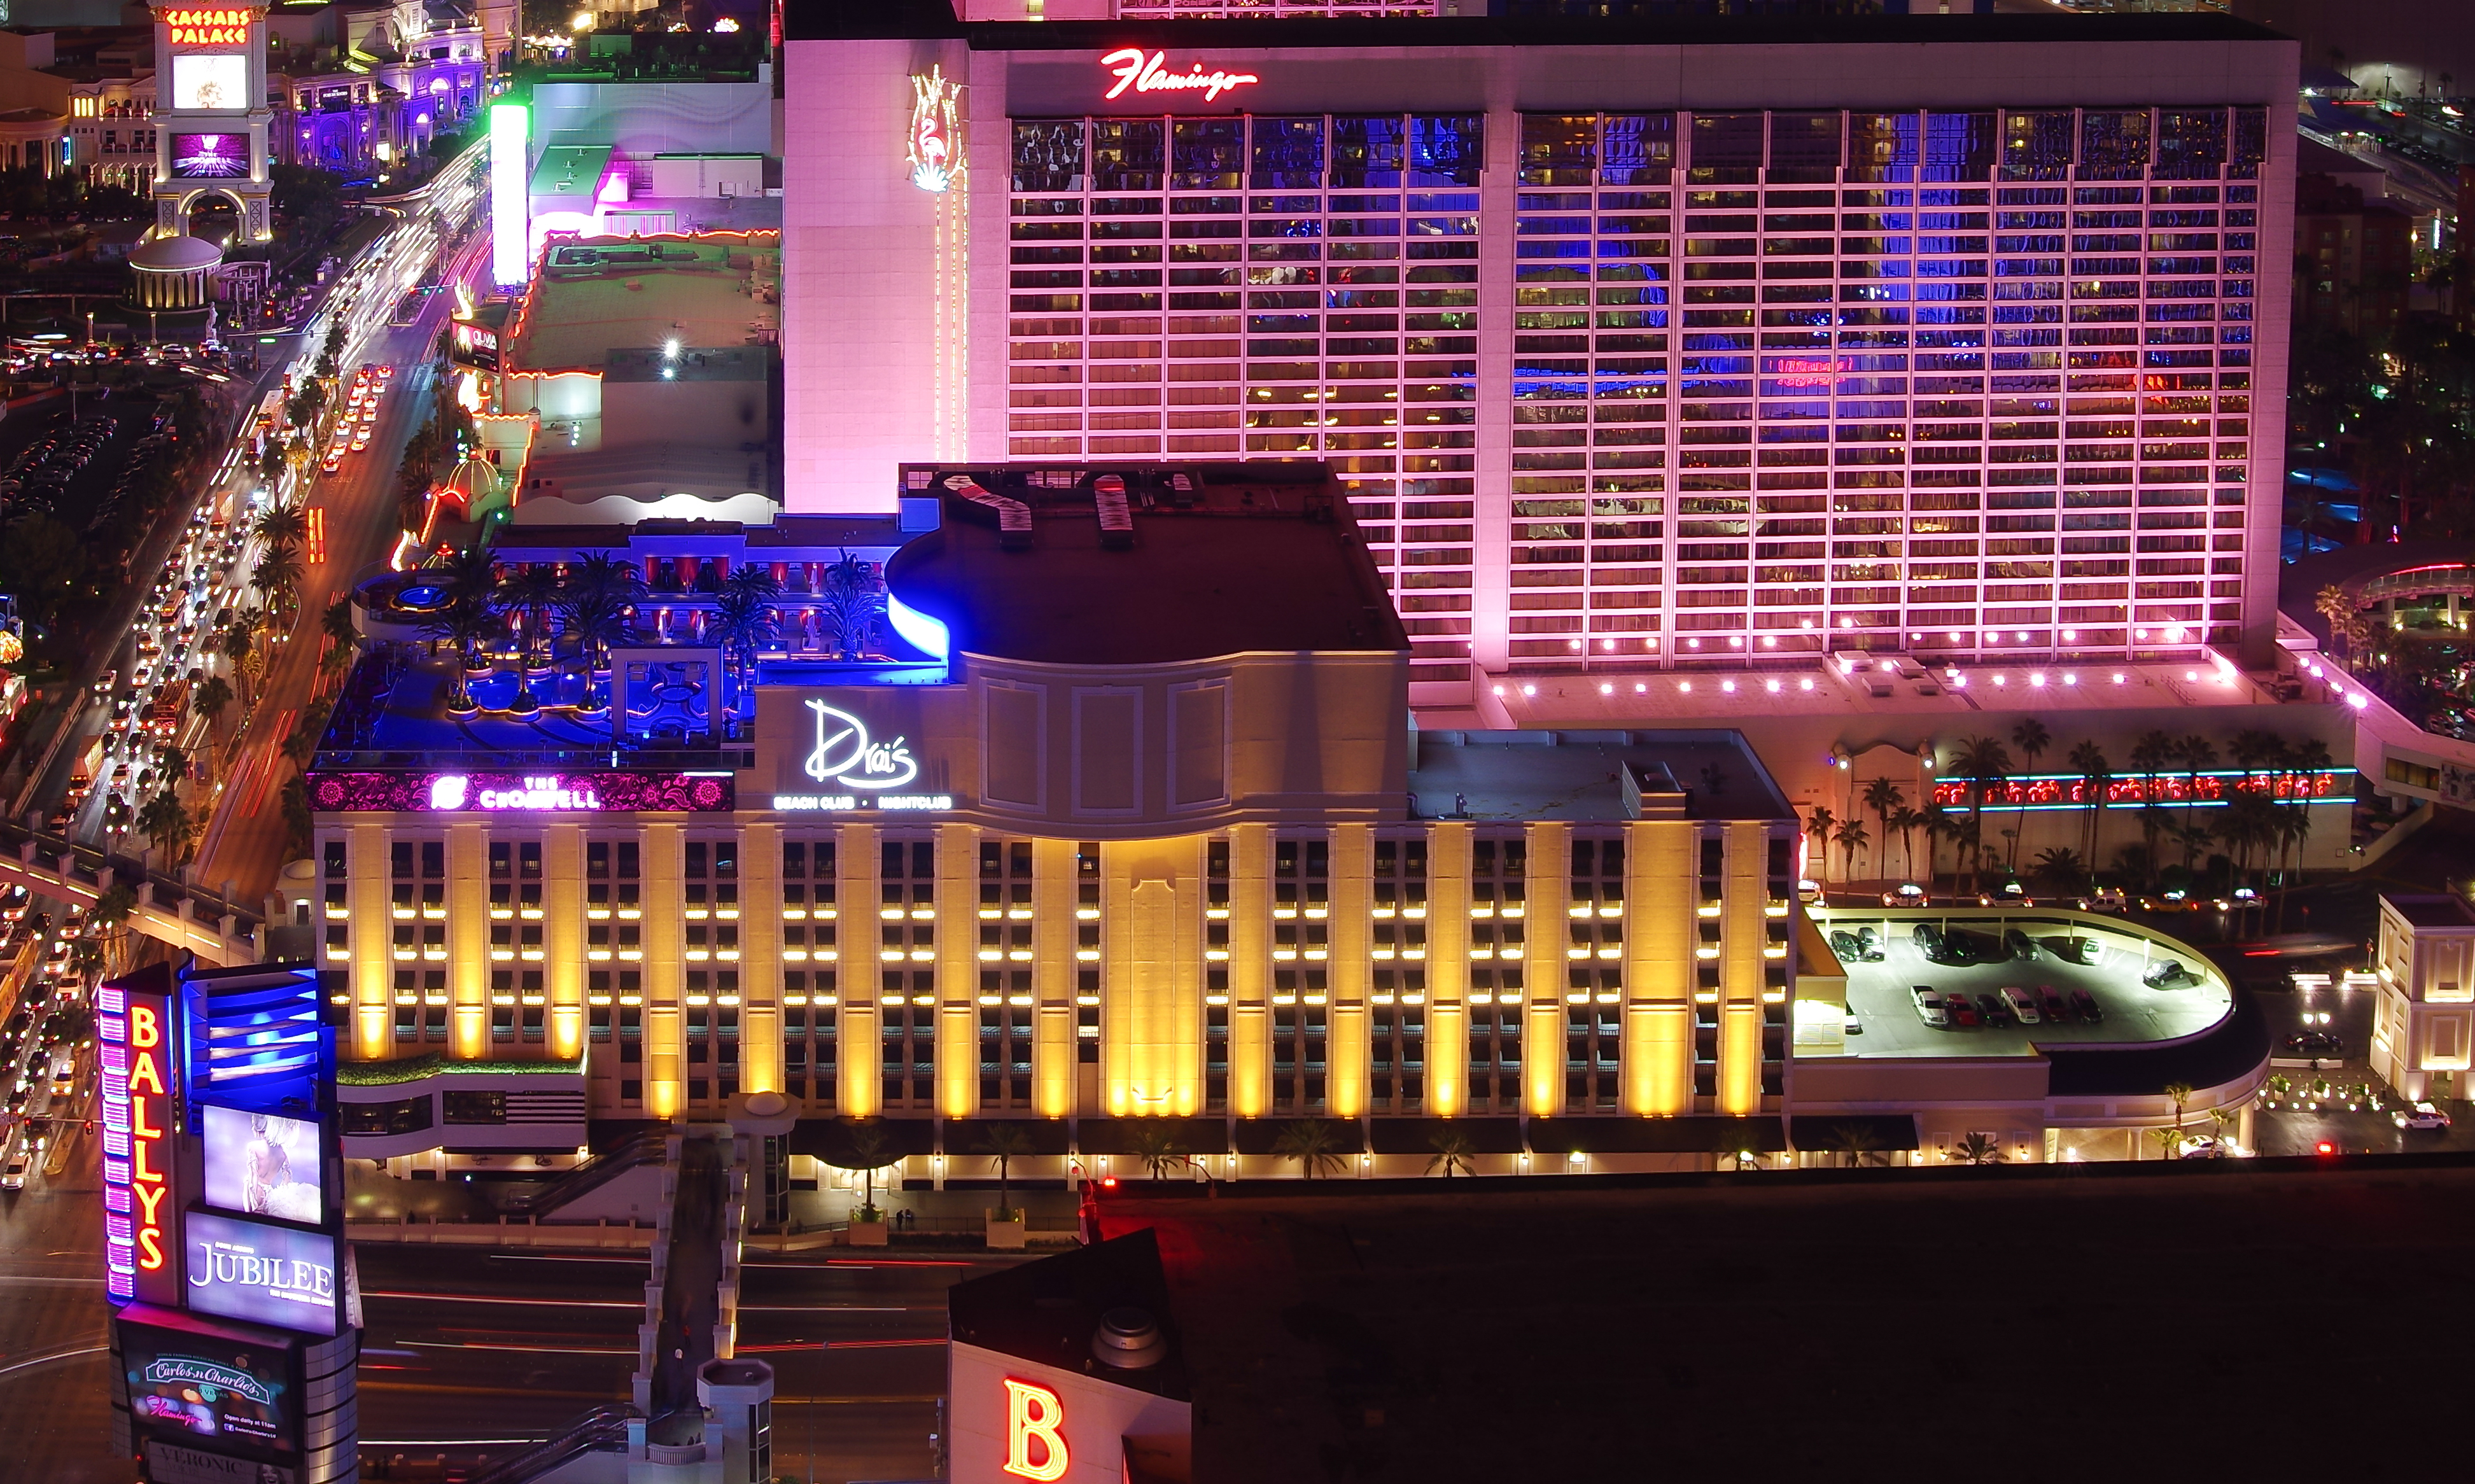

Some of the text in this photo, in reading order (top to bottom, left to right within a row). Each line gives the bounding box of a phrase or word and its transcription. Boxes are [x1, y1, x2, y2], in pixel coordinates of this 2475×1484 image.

[166, 10, 249, 27] CAESARS
[171, 27, 246, 44] PALACE
[1100, 48, 1258, 102] Flamingo
[804, 698, 917, 789] Drai's
[524, 777, 558, 790] THE
[773, 795, 952, 810] BEACH CLUB NIGHTCLUB
[129, 1006, 166, 1269] BALLYS
[189, 1242, 333, 1298] JUBILEE
[146, 1395, 202, 1427] Flamingo
[1002, 1377, 1070, 1483] B
